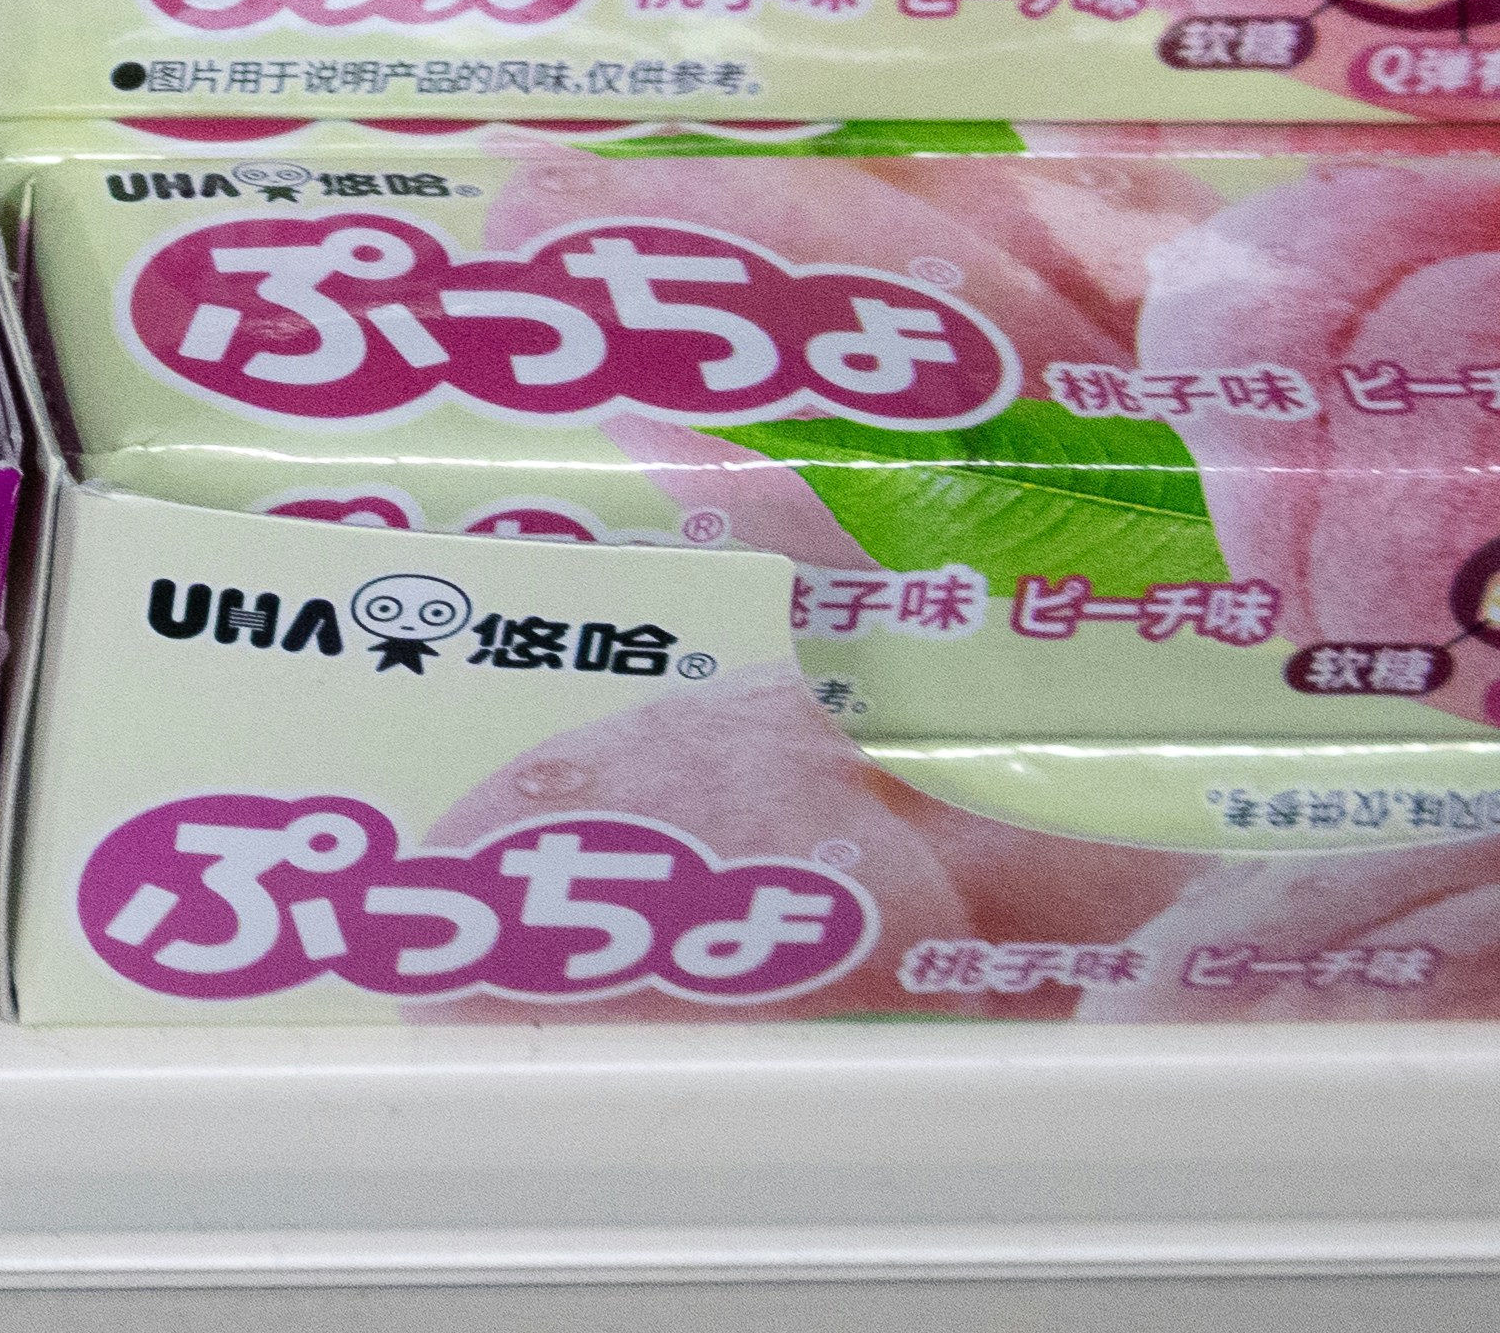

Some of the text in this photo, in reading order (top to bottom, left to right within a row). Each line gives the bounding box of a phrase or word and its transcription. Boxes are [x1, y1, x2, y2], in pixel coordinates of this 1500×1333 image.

[1180, 22, 1299, 66] 软糖
[108, 173, 450, 201] UHA 悠哈
[179, 227, 957, 391] ぷっちょ
[1055, 370, 1305, 415] 桃子味
[147, 579, 678, 677] UHA 悠哈
[1015, 579, 1280, 642] ピーチ味
[1305, 651, 1437, 691] 软糖
[105, 814, 834, 980] ぷっちょ
[905, 947, 1438, 990] 桃子味 ピーチ味
